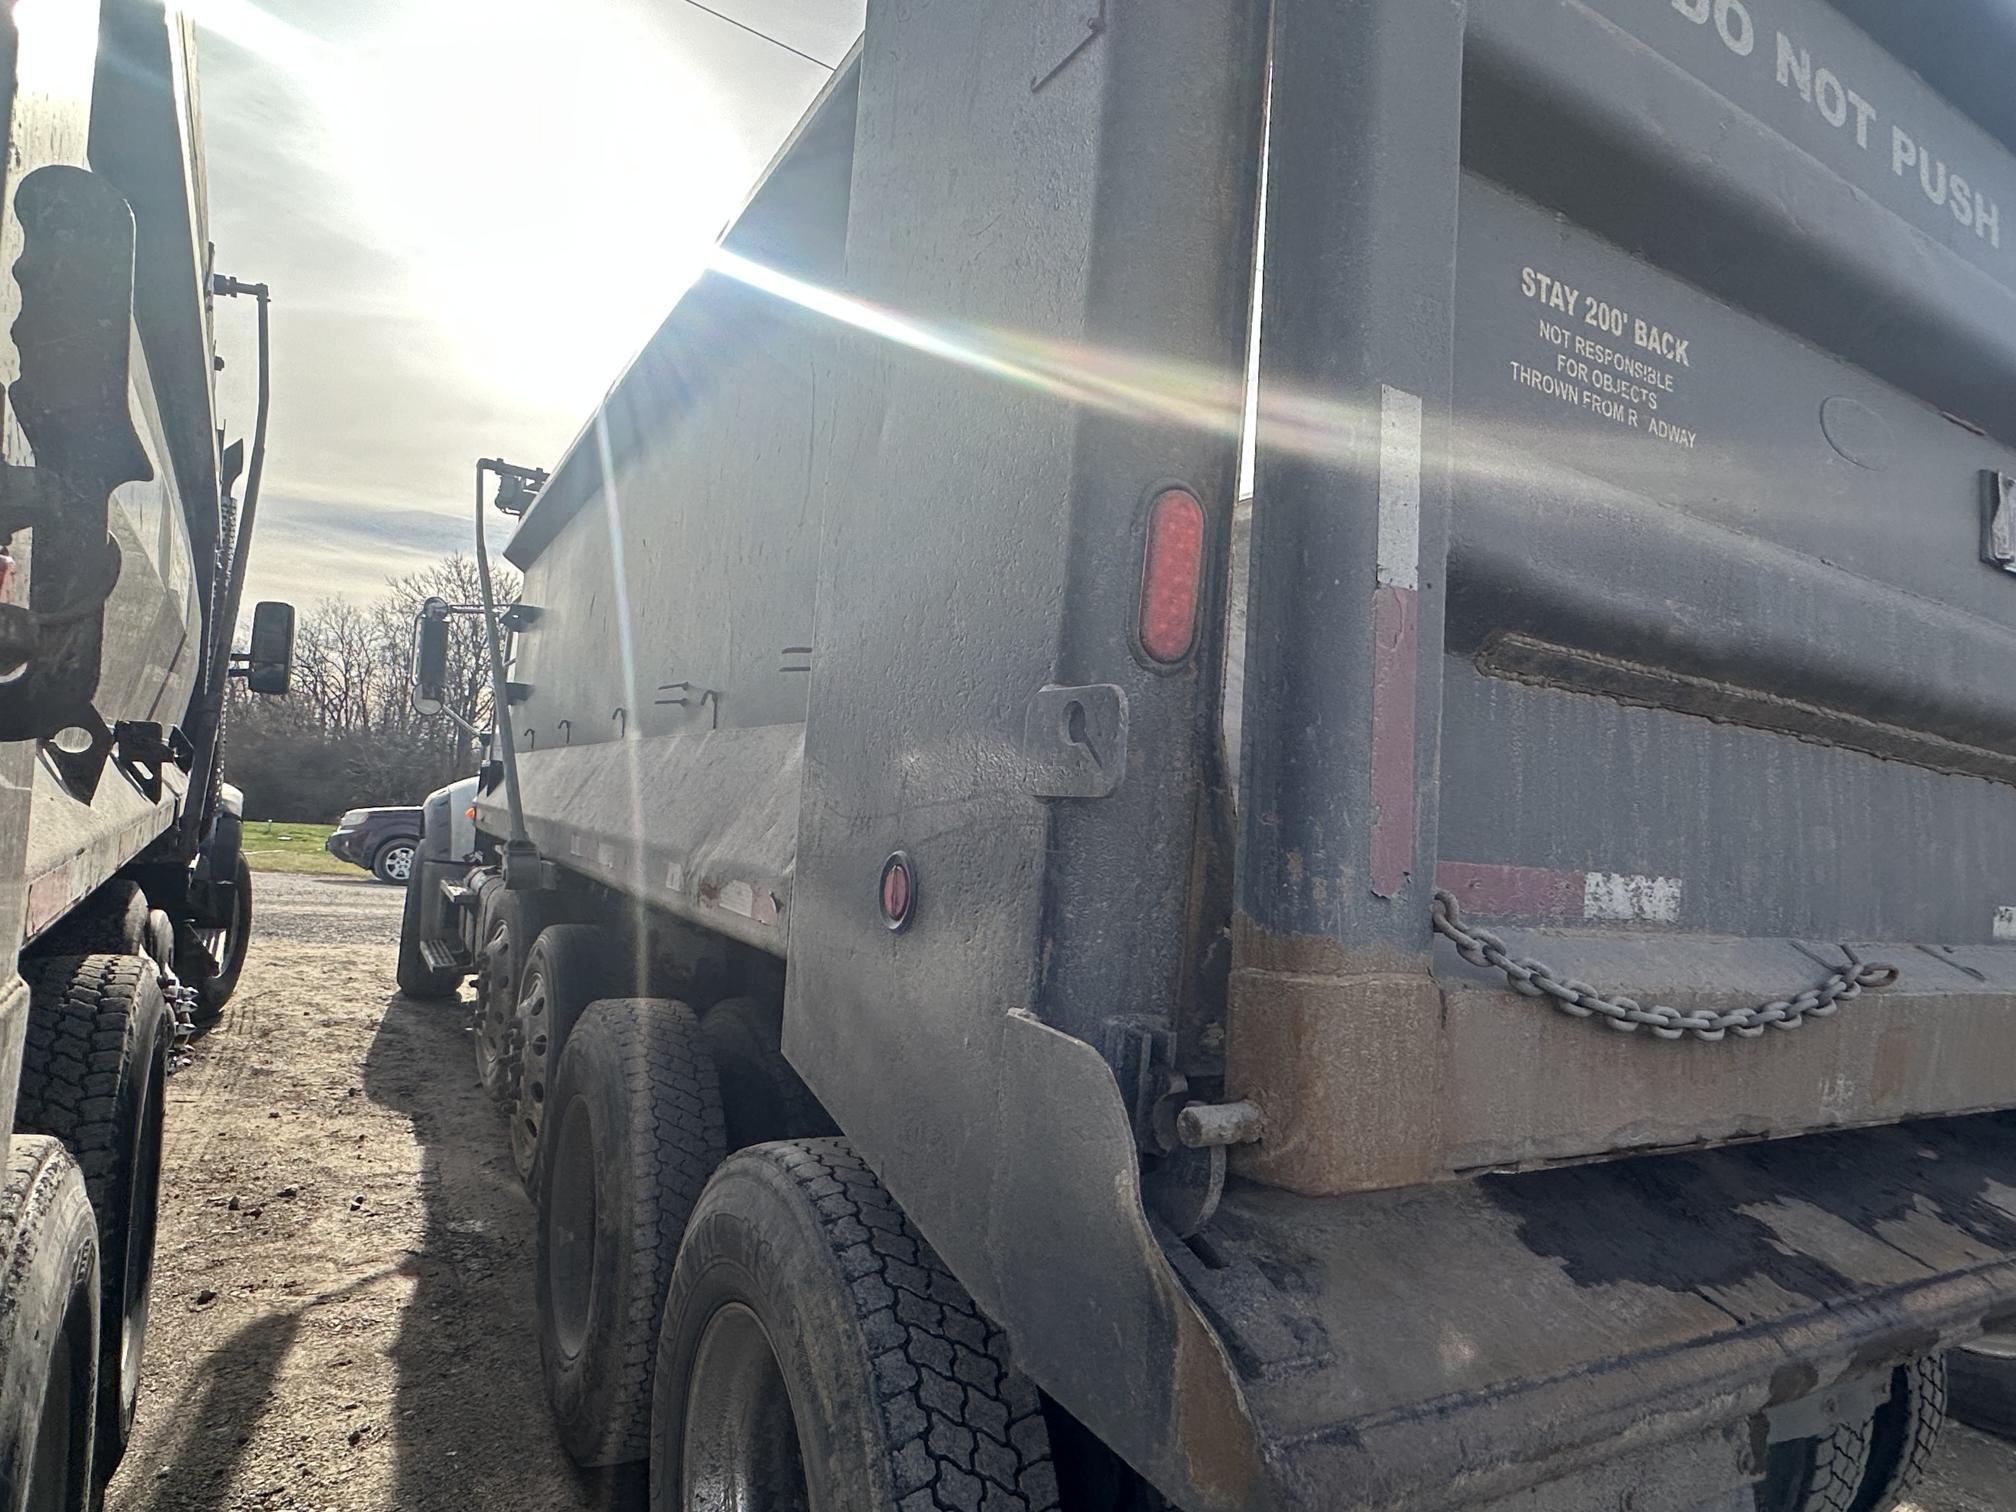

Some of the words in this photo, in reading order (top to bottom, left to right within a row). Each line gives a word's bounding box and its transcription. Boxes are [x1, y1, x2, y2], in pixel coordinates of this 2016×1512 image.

[1776, 31, 1876, 149] NOT
[1892, 125, 1999, 249] PUSH
[1522, 266, 1579, 316] STAY
[1585, 296, 1628, 336] 200'
[1635, 318, 1690, 367] BACK
[1539, 319, 1571, 348] NOT
[1575, 335, 1674, 392] RESPONSIBLE
[1510, 361, 1578, 404] THROWN
[1582, 391, 1624, 422] FROM
[1628, 408, 1697, 448] RADWAY
[1557, 354, 1588, 382] FOR
[1592, 370, 1657, 409] OBJECTS
